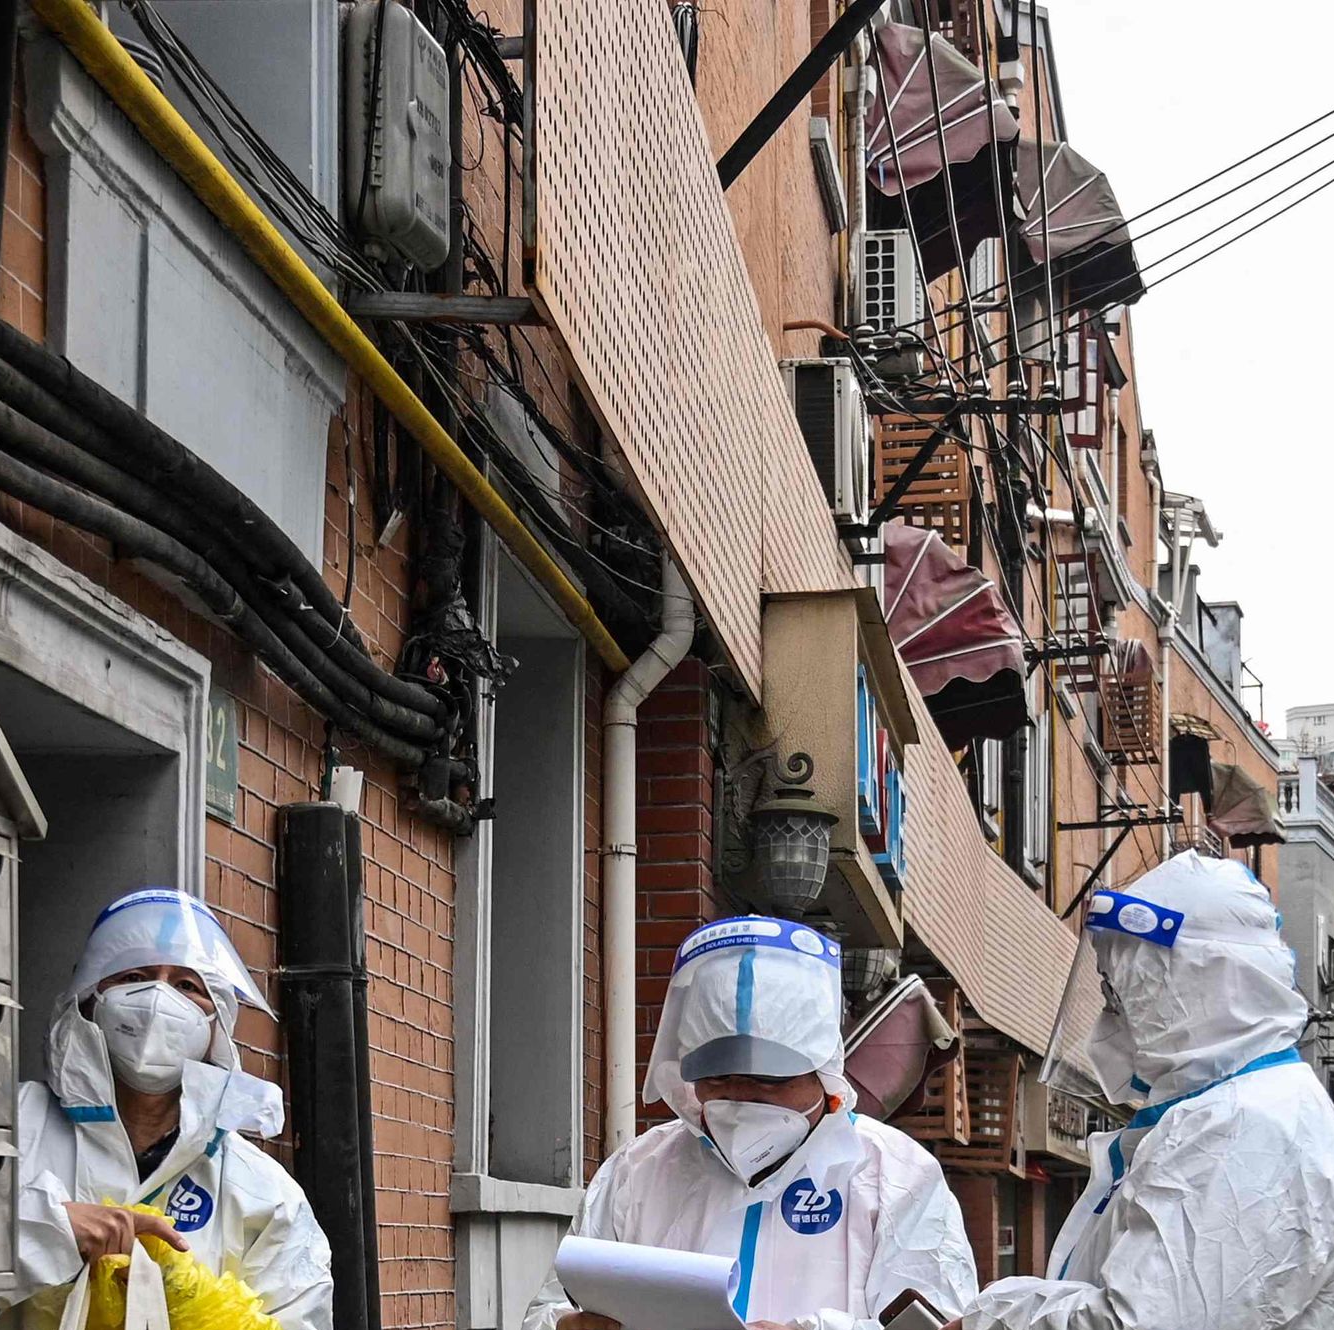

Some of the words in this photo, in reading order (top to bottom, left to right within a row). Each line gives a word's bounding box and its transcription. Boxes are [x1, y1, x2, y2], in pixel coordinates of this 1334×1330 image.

[706, 938, 735, 950] ISOLATION
[736, 936, 759, 944] SHIELD
[793, 1189, 832, 1211] ZD
